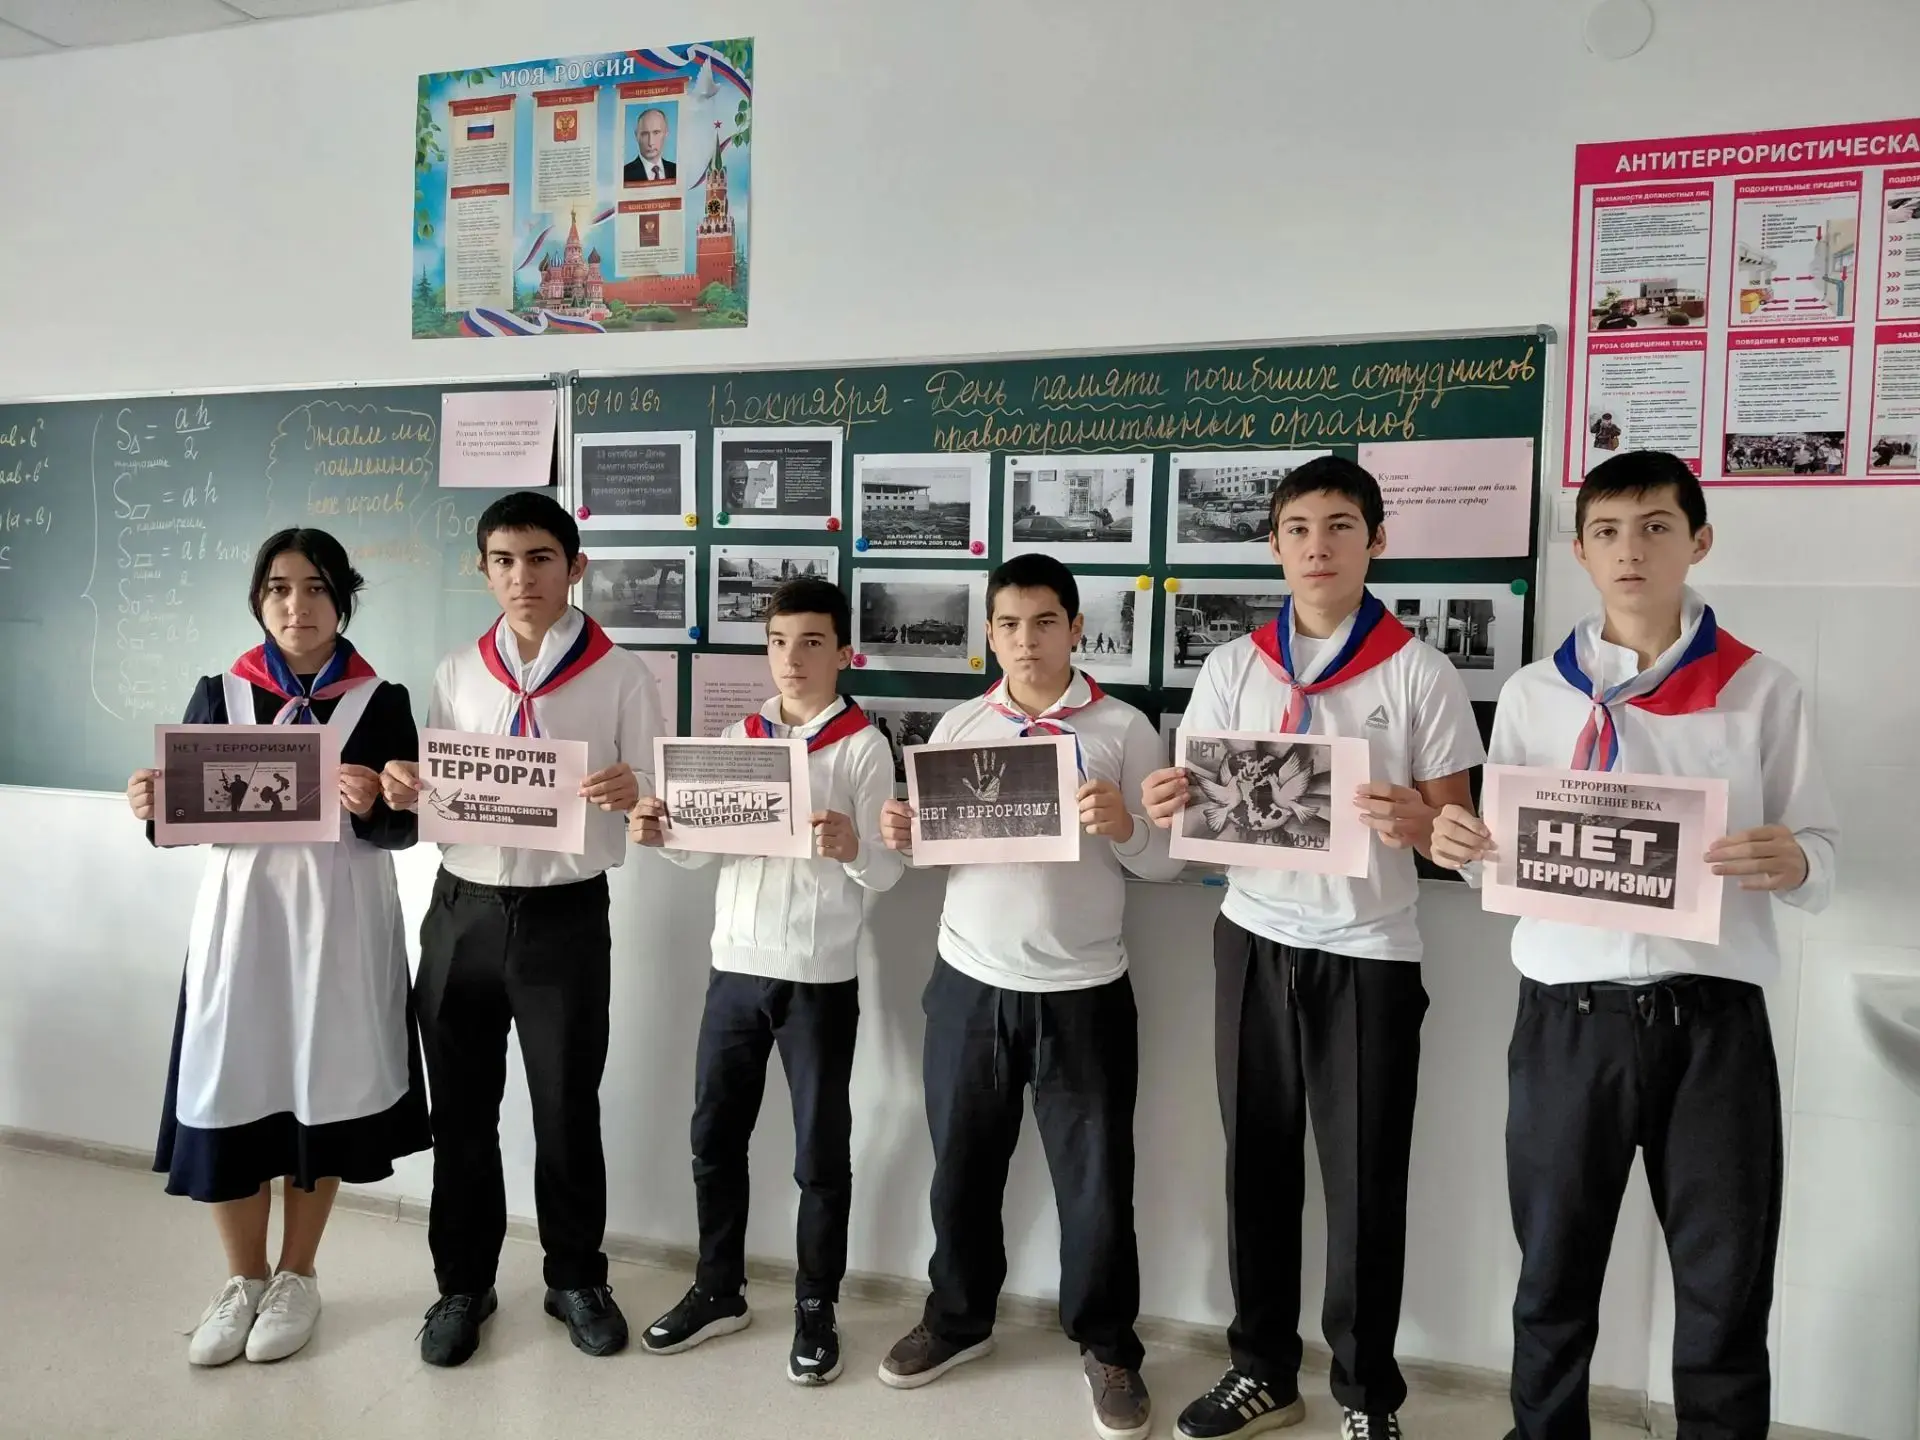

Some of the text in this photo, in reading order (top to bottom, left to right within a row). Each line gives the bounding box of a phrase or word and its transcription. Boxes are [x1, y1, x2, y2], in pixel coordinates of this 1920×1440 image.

[500, 57, 636, 88] МОЯ РОССИЯ
[1739, 180, 1857, 193] ПОДОЗРИТЕЛЬНЫЕ ПРЕДМЕТЫ
[1595, 190, 1710, 203] ОБЯЗАННОСТИ ДОЛЖНОСТНЫХ ЛИЦ
[1591, 339, 1703, 350] УГРОЗА СОВЕРШЕНИЯ ТЕРАКТА
[1735, 337, 1778, 346] ПОВЕДЕНИЕ
[1787, 336, 1811, 344] ТОЛПЕ
[743, 378, 893, 441] октября
[926, 370, 1008, 410] День
[1032, 367, 1169, 401] памяти
[1185, 356, 1340, 393] погибших
[1352, 346, 1535, 408] сотрудников
[934, 397, 1418, 453] правоохранительных органов
[1407, 485, 1437, 494] сердце
[1396, 497, 1423, 506] будет
[1425, 497, 1457, 505] больно
[1458, 497, 1489, 507] сердцу
[173, 743, 199, 753] НЕТ
[215, 743, 312, 753] ТЕРРОРИЗМУ!
[428, 741, 557, 764] ВМЕСТЕ ПРОТИВ
[428, 758, 556, 788] ТЕРРОРА!
[1560, 779, 1627, 794] ТЕРРОРИЗМ
[464, 793, 501, 802] ЗА МИР
[679, 790, 768, 811] РОССИЯ
[1536, 790, 1662, 812] ПРЕСТУПЛЕНИЕ ВЕКА
[464, 803, 553, 817] ЗА БЕЗОПАСНОСТЬ
[464, 812, 515, 823] ЗА ЖИЗНЬ
[681, 804, 742, 819] ПРОТИВ
[920, 802, 1059, 820] НЕТ ТЕРРОРИЗМУ!
[694, 810, 769, 827] ТЕРРОРА!
[1536, 819, 1658, 866] НЕТ
[1519, 858, 1673, 899] ТЕРРОРИЗМУ
